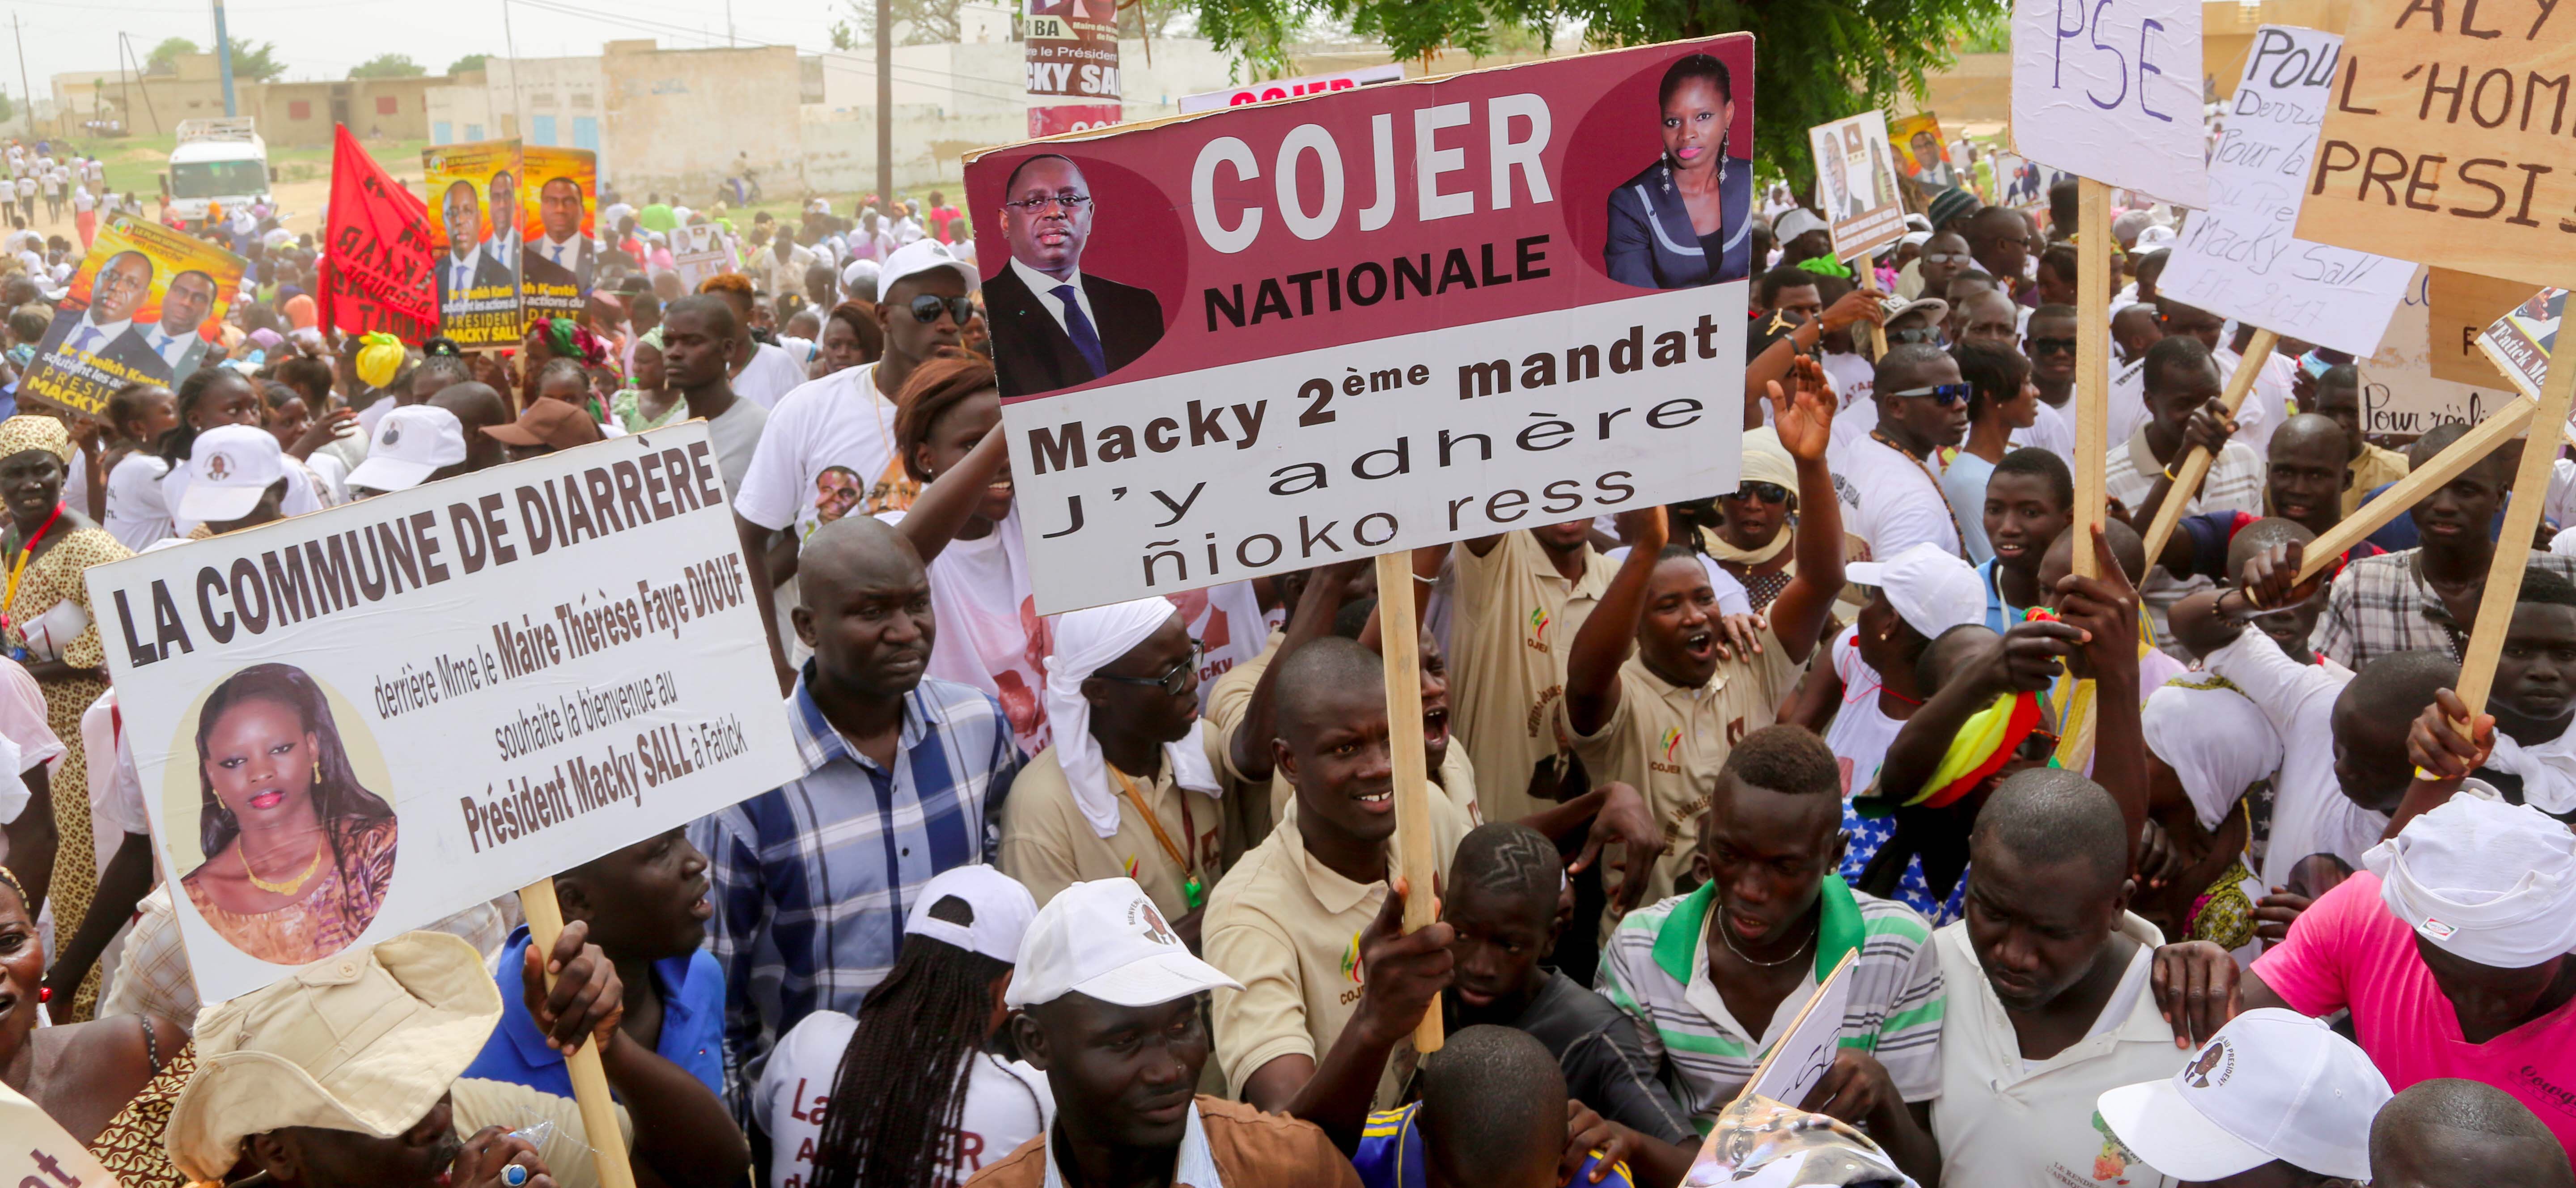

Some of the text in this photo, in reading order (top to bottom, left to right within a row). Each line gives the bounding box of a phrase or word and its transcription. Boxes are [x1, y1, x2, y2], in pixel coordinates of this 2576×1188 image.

[1035, 20, 1059, 36] BA
[1041, 47, 1052, 56] le
[2052, 0, 2172, 122] PSE
[2339, 56, 2576, 138] L'HOM
[1191, 93, 1554, 254] COJER
[2312, 140, 2576, 233] PRESI
[1203, 234, 1551, 332] NATIONALE
[2188, 215, 2383, 286] Macky Sall
[448, 311, 516, 328] PRESIDENT
[527, 296, 585, 309] actions du
[538, 282, 578, 297] Kanté
[59, 343, 77, 357] Dr
[78, 350, 126, 376] Cheikh
[443, 327, 490, 344] MACKY
[491, 325, 521, 342] SALL
[26, 375, 108, 415] MACKY
[1028, 314, 1718, 475] Macky 2ème mandat
[2364, 383, 2428, 432] Pour
[1268, 398, 1703, 496] adhère
[114, 435, 723, 668] LA COMMUNE DE DIARRÈRE
[1143, 471, 1635, 586] ñioko ress
[375, 552, 745, 719] derrière Mme le Maire Thérèse Faye DIOUF
[496, 670, 678, 762] souhaite la bienvenue au
[460, 713, 749, 854] Président Macky SALL à Fatick
[1340, 985, 1364, 1006] COJ
[2217, 1048, 2235, 1087] PRESIDENT
[2054, 1162, 2064, 1173] LE
